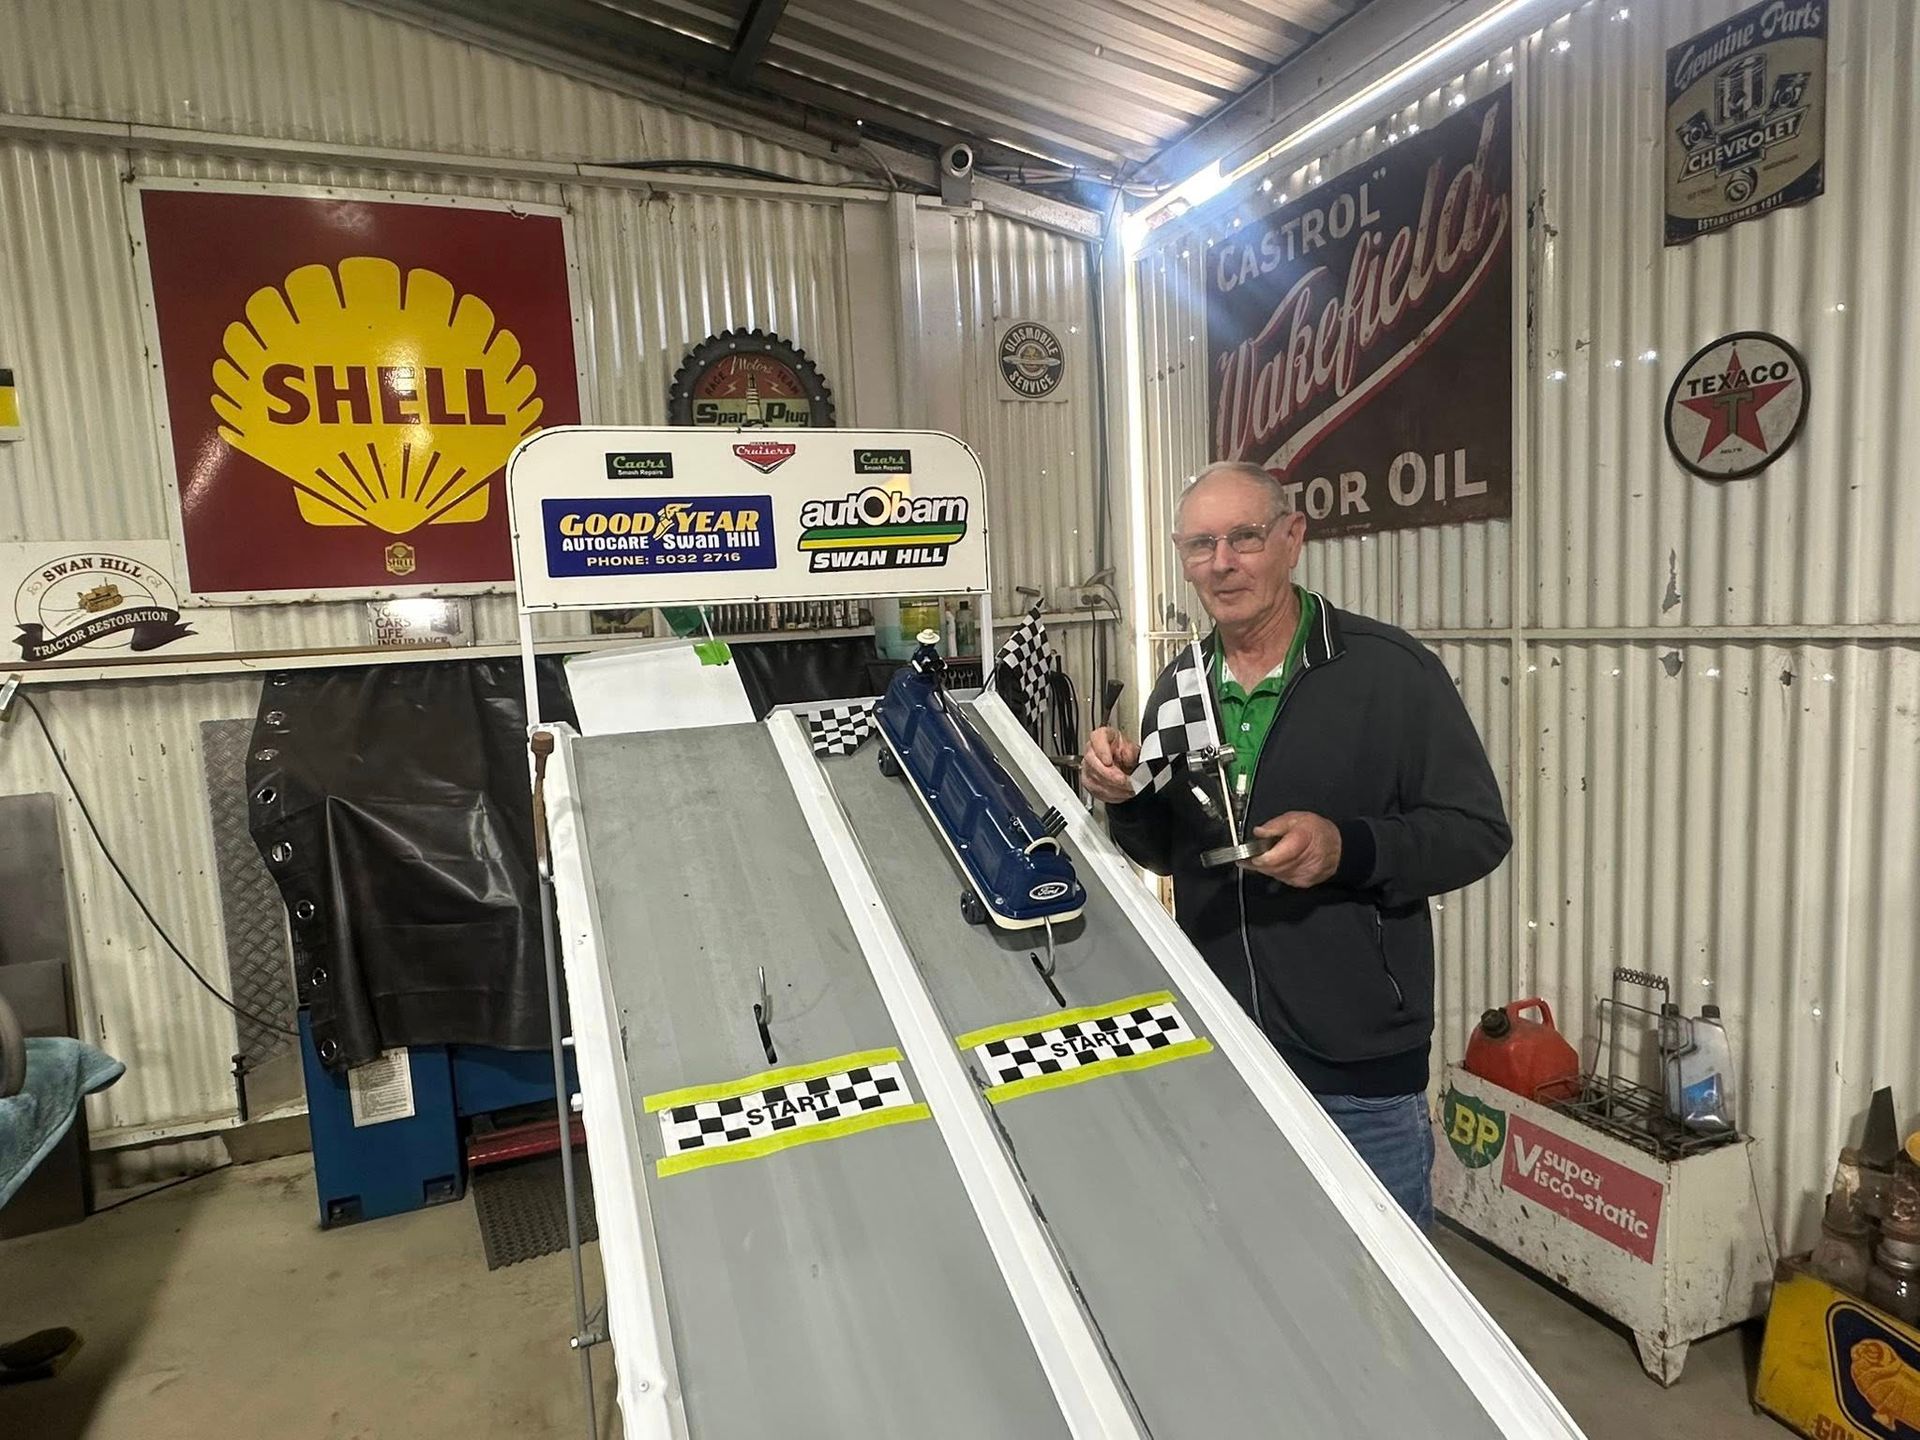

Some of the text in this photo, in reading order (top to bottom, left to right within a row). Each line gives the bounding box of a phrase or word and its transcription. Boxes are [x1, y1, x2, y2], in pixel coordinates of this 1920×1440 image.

[1674, 1, 1821, 91] Genuine Parts
[1688, 116, 1797, 172] CHEVROLET
[1217, 102, 1508, 463] Wakefield
[1005, 327, 1059, 356] OLDSMOBILE
[706, 371, 799, 396] RACE TEAM
[1009, 371, 1054, 393] SERVICE
[1687, 361, 1789, 397] TEXACO
[261, 364, 506, 425] SHELL
[696, 403, 809, 426] Spar Plug
[613, 456, 667, 469] Caars
[736, 446, 791, 455] Cruisers
[860, 452, 906, 465] Caars
[1284, 449, 1488, 520] TOR OIL
[562, 531, 760, 551] AUTOCARE Swan Hill
[42, 558, 142, 582] SWAN HILL
[587, 553, 741, 567] PHONE: 5032 2716
[813, 547, 944, 569] SWAN HILL
[33, 611, 168, 657] TRACTOR RESTORATION
[375, 618, 411, 629] CARS
[377, 628, 403, 639] LIFE
[1037, 886, 1060, 896] Ford
[1050, 1030, 1119, 1057] START
[746, 1091, 829, 1125] START
[1450, 1103, 1499, 1155] BP
[1543, 1150, 1603, 1190] super
[1513, 1134, 1649, 1240] Visco-static
